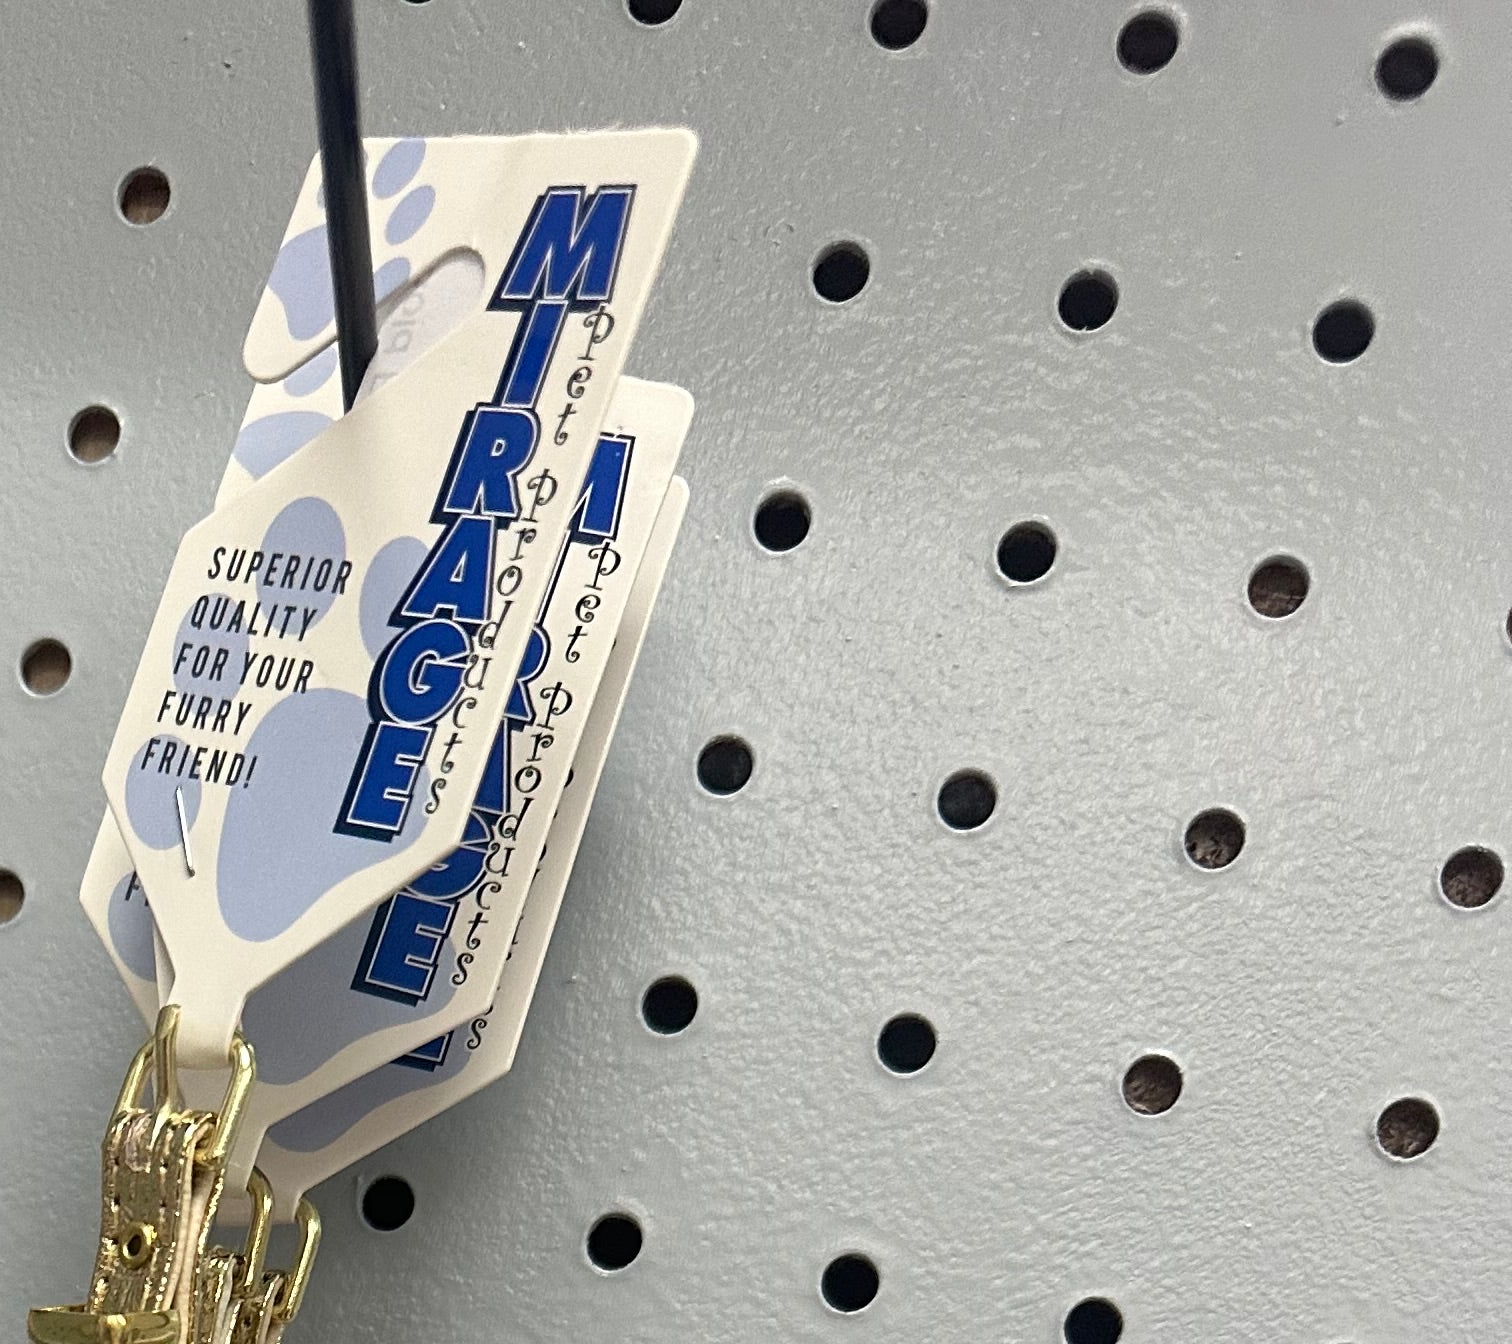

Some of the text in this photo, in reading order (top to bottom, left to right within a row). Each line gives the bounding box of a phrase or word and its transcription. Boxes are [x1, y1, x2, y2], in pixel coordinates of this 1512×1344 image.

[333, 184, 638, 843] MIRAGE
[207, 546, 353, 595] SUPERIOR
[190, 595, 319, 642] QUALITY
[173, 642, 315, 694] FOR YOUR
[156, 691, 253, 736] FURRY
[140, 738, 259, 789] FRIEND!
